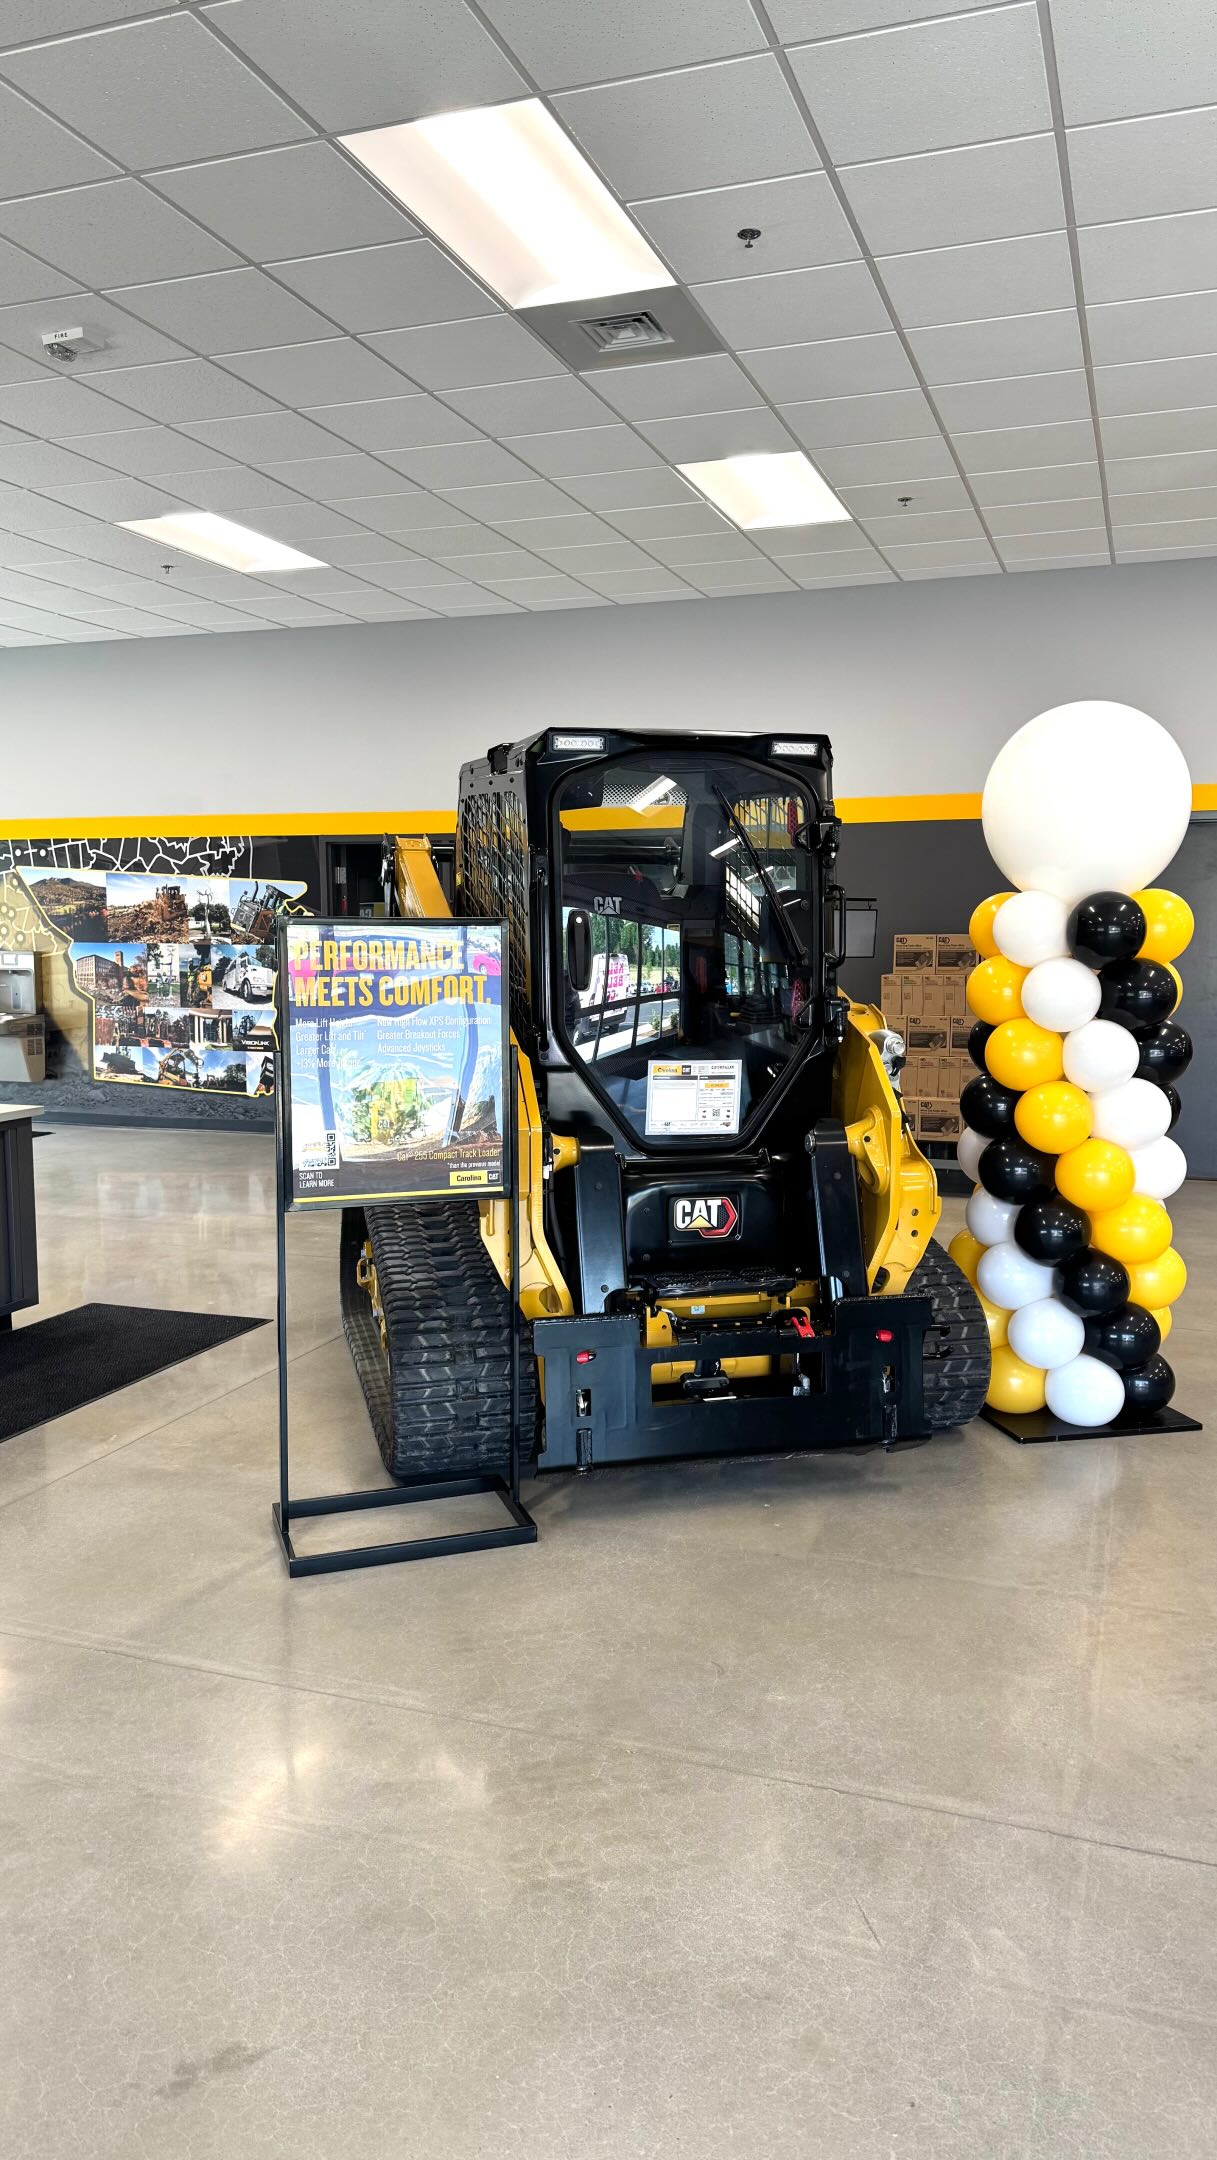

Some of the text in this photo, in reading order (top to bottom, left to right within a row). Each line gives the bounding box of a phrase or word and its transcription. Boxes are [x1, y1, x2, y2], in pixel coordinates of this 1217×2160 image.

[594, 897, 622, 914] CAT
[293, 940, 464, 971] PERFORMANCE
[295, 975, 491, 1007] MEETS COMFORT.
[296, 1018, 314, 1028] More
[316, 1018, 328, 1028] Lift
[377, 1018, 393, 1027] New
[412, 1016, 427, 1027] Flow
[429, 1015, 444, 1026] XPS
[445, 1015, 491, 1027] Configuration
[296, 1031, 323, 1042] Greater
[325, 1030, 337, 1041] Lift
[338, 1030, 352, 1041] and
[377, 1030, 404, 1040] Greater
[405, 1029, 436, 1040] Breakout
[296, 1045, 319, 1057] Larger
[377, 1042, 446, 1054] Advanced Joysticks
[317, 1057, 335, 1068] More
[414, 1151, 428, 1160] 255
[429, 1150, 458, 1160] Compact
[460, 1148, 477, 1158] Track
[478, 1147, 500, 1158] Loader
[299, 1171, 323, 1180] SCAN TO
[456, 1174, 482, 1182] Carolina
[299, 1179, 335, 1189] LEARN MORE
[676, 1199, 722, 1229] CAT
